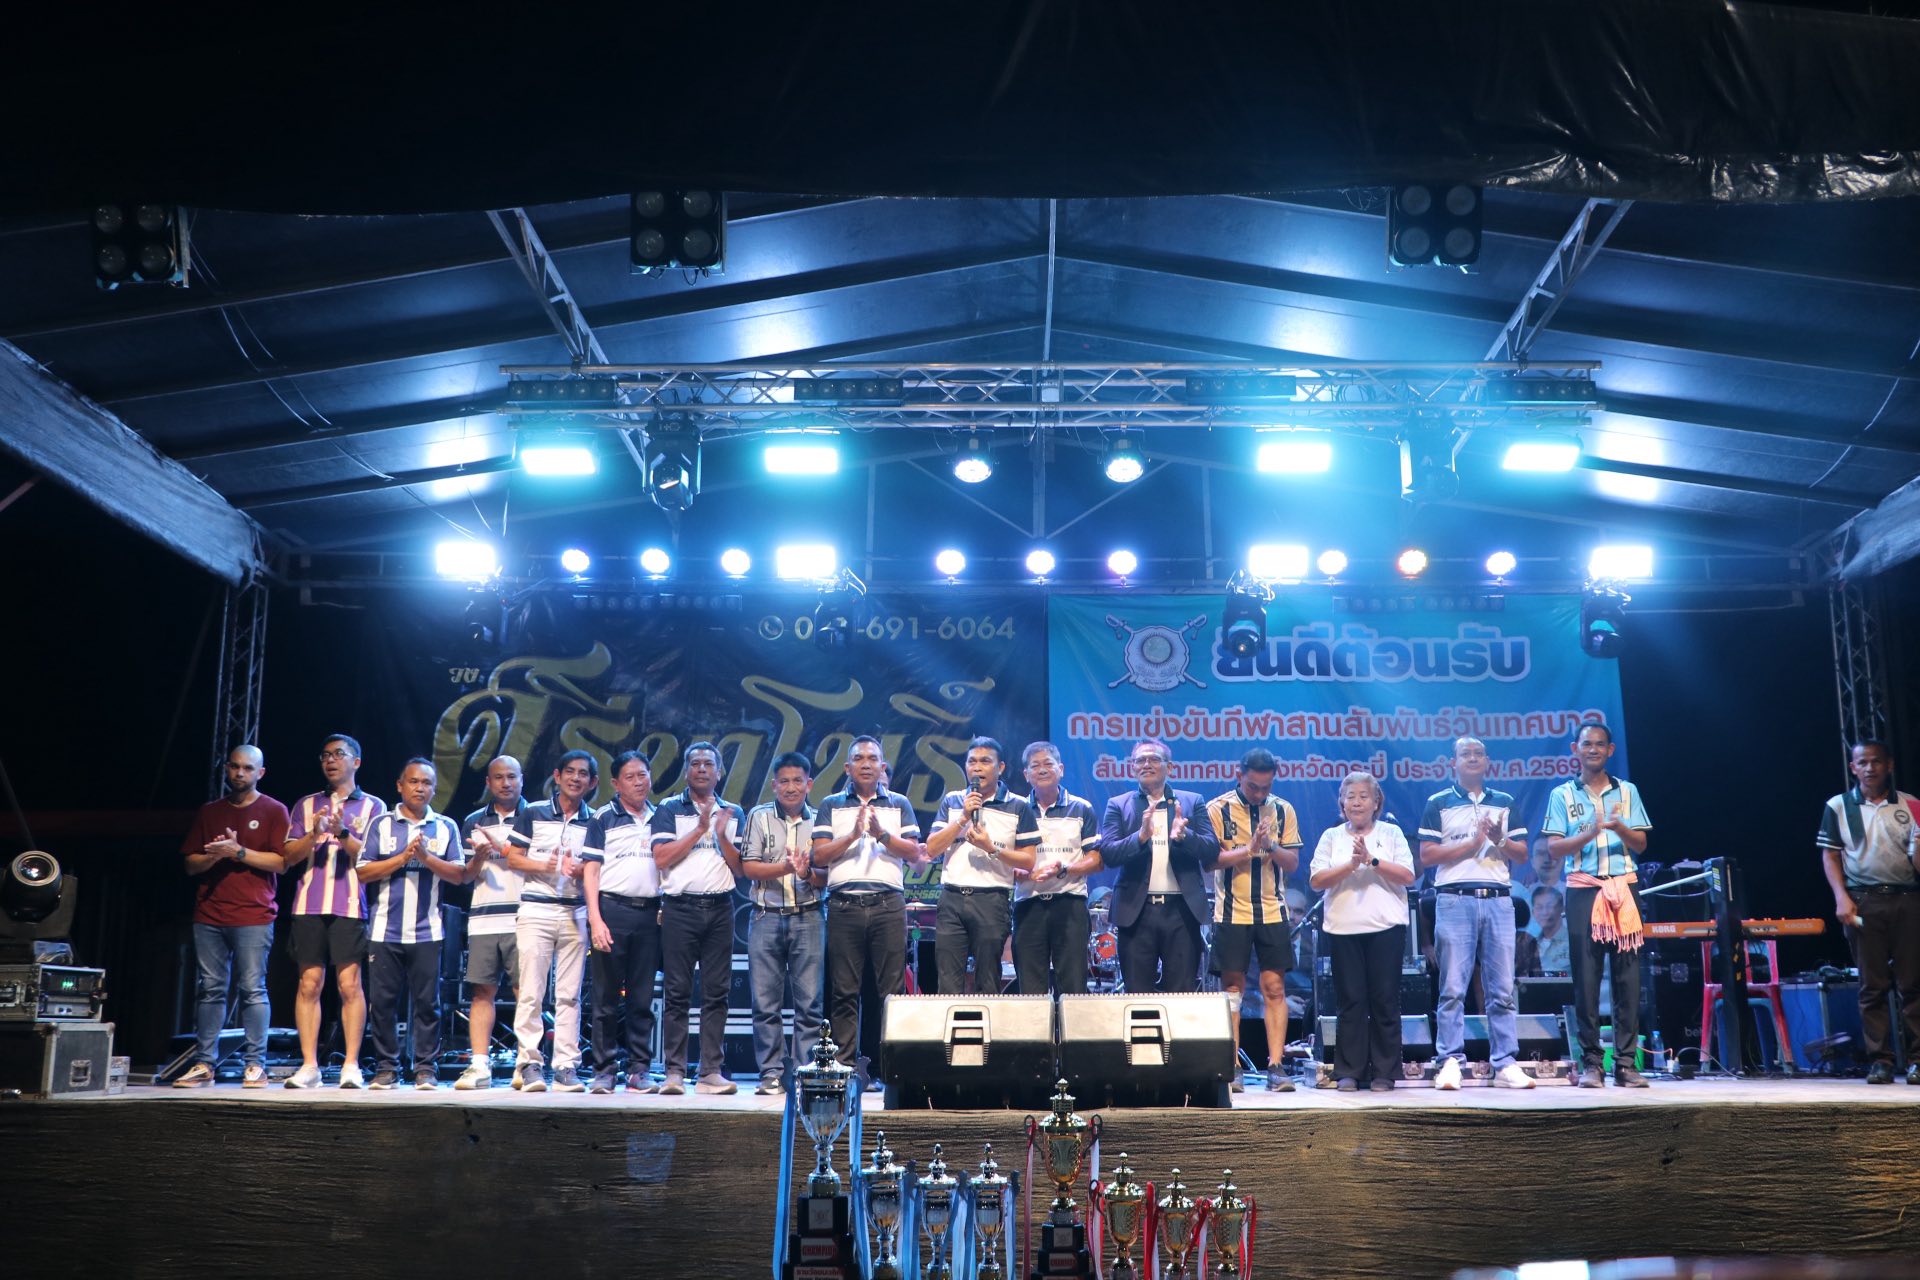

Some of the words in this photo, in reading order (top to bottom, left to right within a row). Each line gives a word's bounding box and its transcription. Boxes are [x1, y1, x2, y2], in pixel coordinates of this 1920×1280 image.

[794, 615, 1015, 640] 0-691-6064
[1213, 623, 1529, 681] ยนดีต้อนรับ
[1569, 802, 1584, 818] 20
[763, 833, 775, 848] 18
[1651, 924, 1677, 934] KORG
